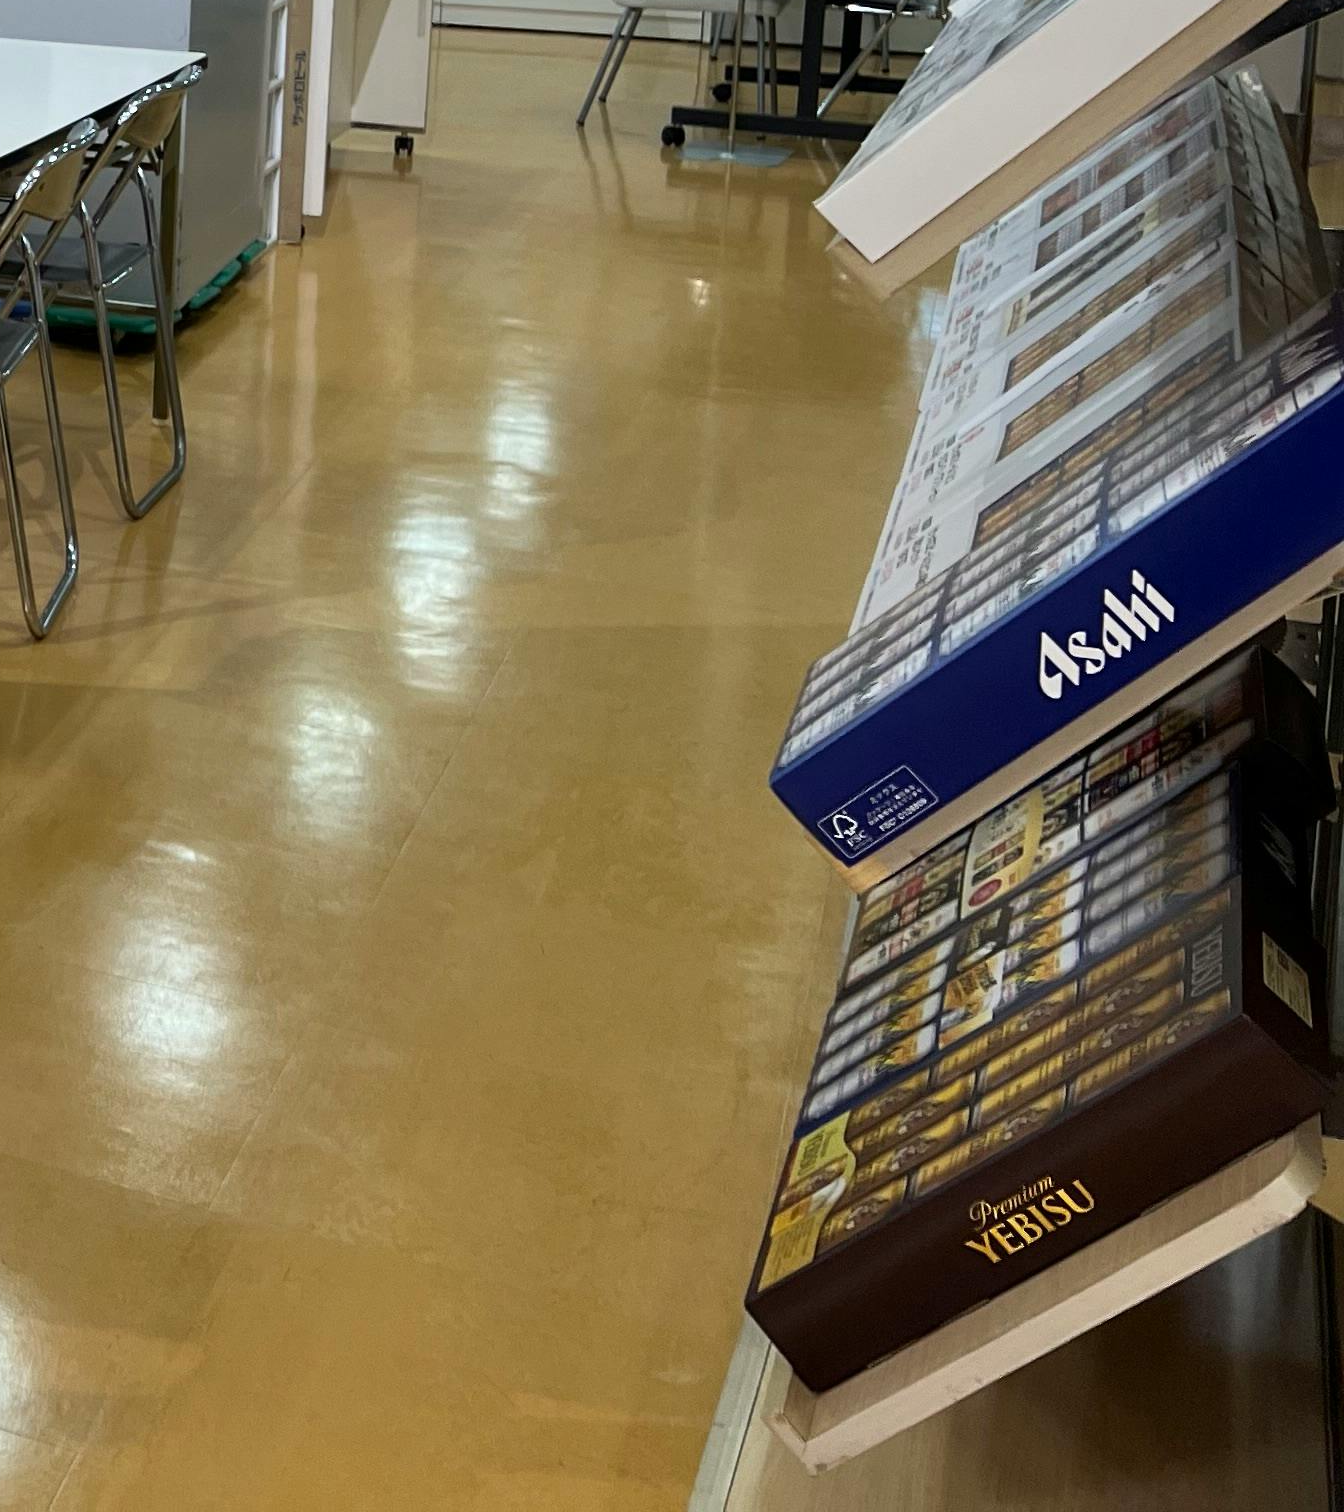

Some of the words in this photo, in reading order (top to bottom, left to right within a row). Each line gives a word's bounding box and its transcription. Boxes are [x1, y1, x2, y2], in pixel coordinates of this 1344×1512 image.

[1039, 569, 1176, 700] Asahi
[963, 1179, 1097, 1266] YEBISU
[968, 1176, 1055, 1231] Premium
